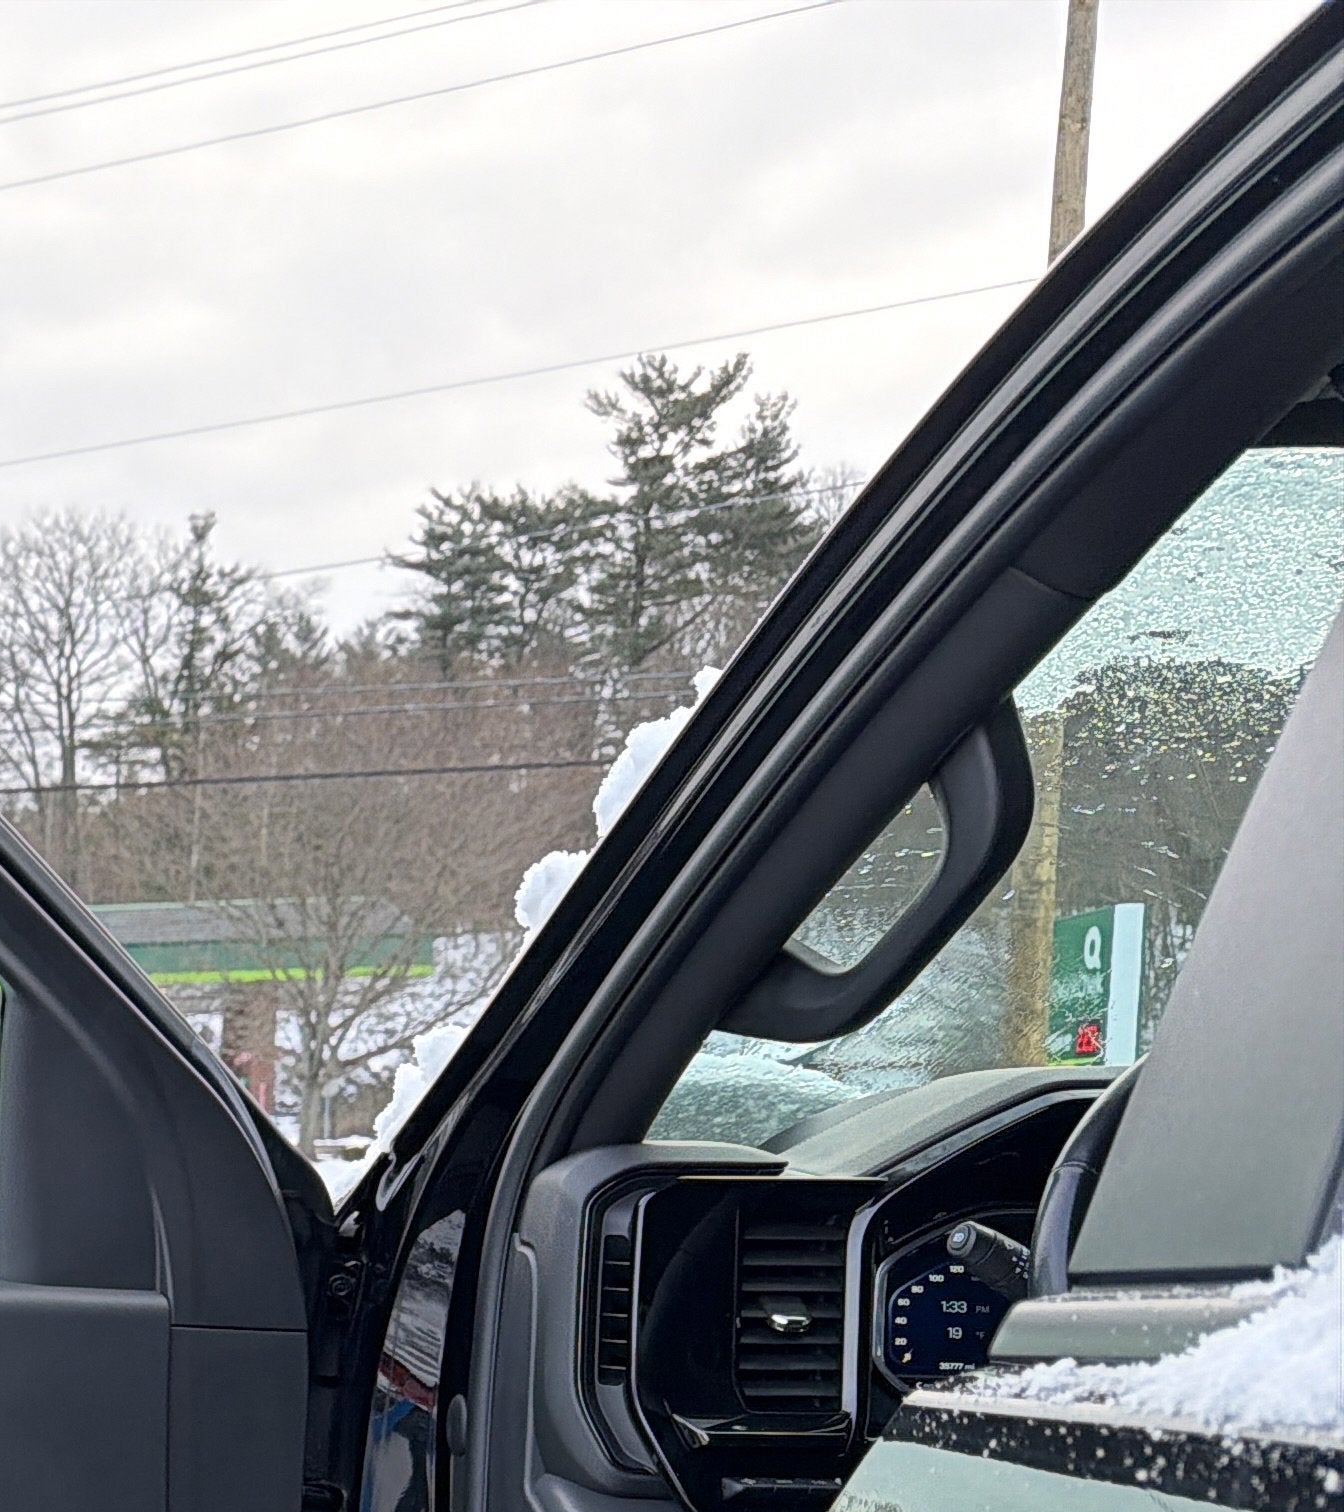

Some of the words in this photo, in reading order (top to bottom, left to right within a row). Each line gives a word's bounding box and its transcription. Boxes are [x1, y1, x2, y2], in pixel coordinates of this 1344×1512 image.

[950, 1265, 964, 1273] 120
[929, 1274, 944, 1282] 100
[941, 1301, 967, 1313] 1:33
[975, 1304, 990, 1314] PM
[895, 1316, 907, 1324] 40
[947, 1327, 962, 1339] 19
[895, 1337, 907, 1345] 20
